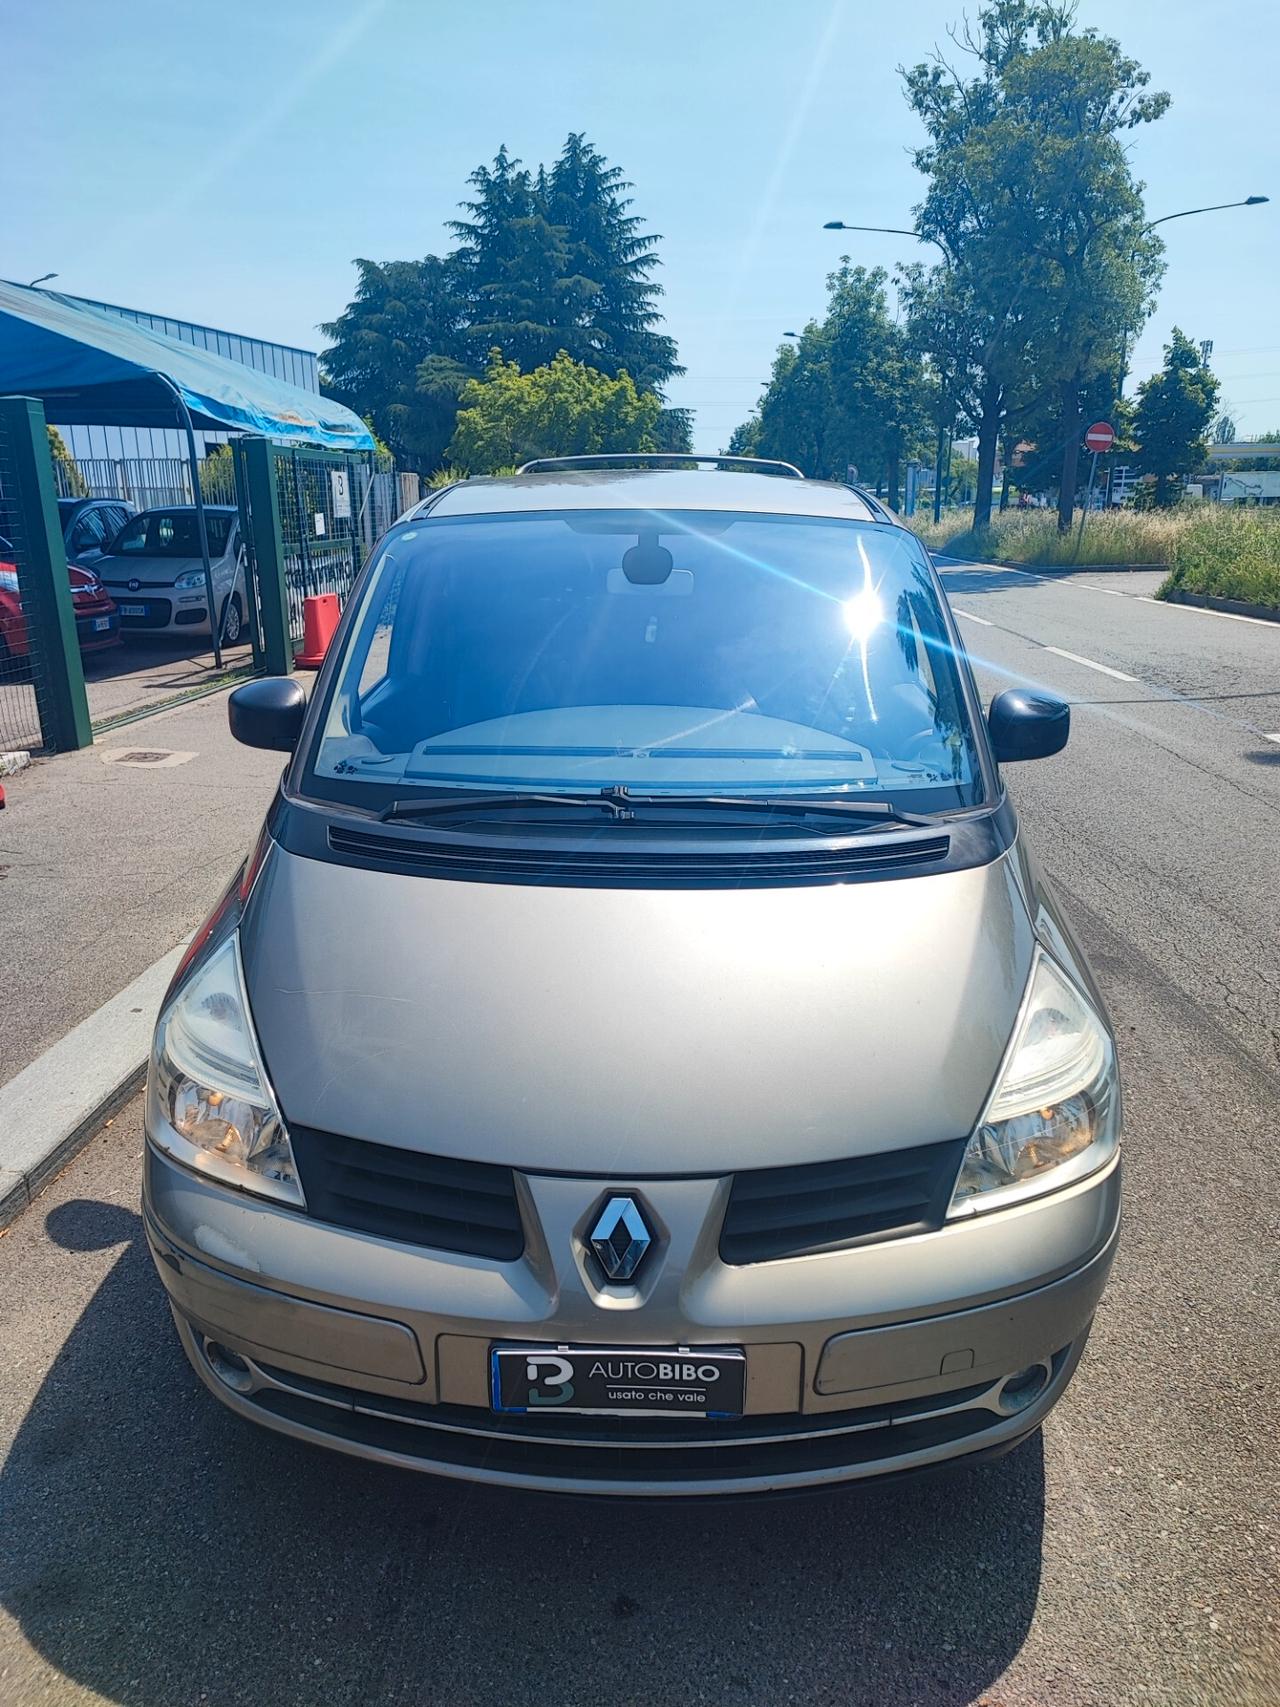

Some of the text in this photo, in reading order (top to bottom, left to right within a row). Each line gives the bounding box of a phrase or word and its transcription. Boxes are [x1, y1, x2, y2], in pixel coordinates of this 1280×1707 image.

[588, 1361, 720, 1382] AUTOBIBO
[608, 1390, 706, 1403] usato che vale
